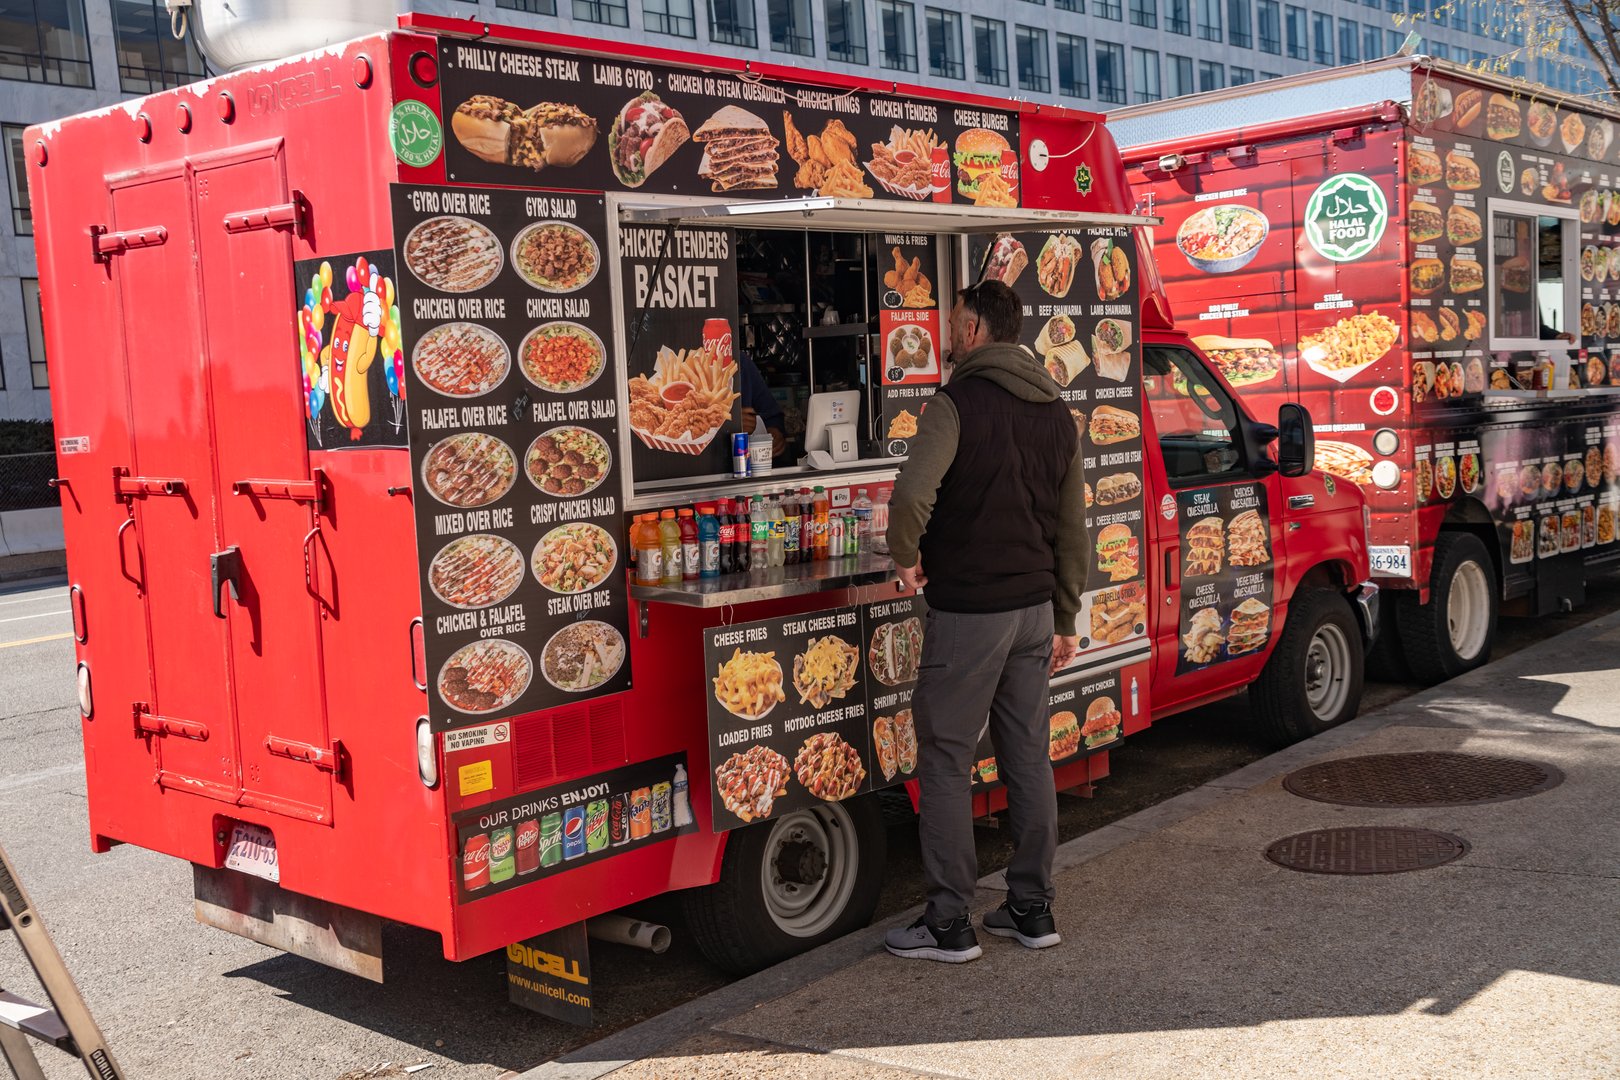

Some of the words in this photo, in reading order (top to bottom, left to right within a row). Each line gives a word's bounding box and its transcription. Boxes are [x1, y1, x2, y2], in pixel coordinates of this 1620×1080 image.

[457, 46, 497, 72] PHILLY
[500, 51, 543, 78] CHEESE
[545, 58, 580, 82] STEAK
[593, 64, 622, 87] LAMB
[625, 68, 654, 91] GYRO
[668, 73, 703, 95] CHICKEN
[704, 81, 715, 96] OR
[717, 82, 741, 100] STEAK
[742, 83, 786, 105] QUESADILLA
[797, 89, 833, 111] CHICKEN
[834, 94, 860, 114] WINGS
[869, 98, 905, 119] CHICKEN
[905, 103, 938, 124] TENDERS
[954, 108, 980, 127] CHEESE
[981, 112, 1008, 131] BURGER
[412, 191, 439, 213] GYRO
[441, 192, 467, 214] OVER
[468, 193, 491, 215] RICE
[525, 197, 549, 218] GYRO
[551, 198, 577, 219] SALAD
[1326, 195, 1369, 217] حلال
[1329, 217, 1365, 229] HALAL
[885, 234, 905, 246] WINGS
[905, 235, 912, 245] &
[912, 235, 928, 247] FRIES
[1329, 226, 1366, 241] FOOD
[674, 230, 729, 260] TENDERS
[634, 264, 719, 309] BASKET
[413, 298, 456, 320] CHICKEN
[458, 298, 480, 320] OVER
[481, 298, 506, 319] RICE
[526, 298, 563, 319] CHICKEN
[564, 298, 590, 318] SALAD
[890, 312, 915, 323] FALAFEL
[916, 311, 930, 322] SIDE
[1039, 305, 1052, 317] BEEF
[1053, 304, 1083, 317] SHAWARMA
[1090, 305, 1103, 316] LAMB
[1104, 304, 1132, 316] SHAWARMA
[887, 389, 899, 399] ADD
[899, 388, 914, 398] FRIES
[915, 387, 920, 397] &
[1072, 389, 1088, 401] STEAK
[1095, 388, 1115, 400] CHICKEN
[1116, 386, 1133, 398] CHEESE
[421, 408, 460, 430] FALAFEL
[462, 406, 486, 428] OVER
[487, 405, 508, 426] RICE
[533, 402, 567, 423] FALAFEL
[568, 401, 589, 421] OVER
[591, 399, 616, 419] SALAD
[1084, 457, 1096, 469] STEAK
[1193, 492, 1210, 505] STEAK
[1234, 486, 1254, 498] CHICKEN
[530, 502, 557, 525] CRISPY
[558, 499, 592, 521] CHICKEN
[592, 497, 615, 518] SALAD
[1186, 502, 1219, 518] QUESADILLA
[1230, 495, 1260, 510] QUESADILLA
[435, 513, 465, 536] MIXED
[466, 511, 490, 533] OVER
[492, 508, 514, 529] RICE
[1096, 514, 1112, 526] CHEESE
[1112, 511, 1127, 524] BURGER
[1235, 572, 1264, 588] VEGETABLE
[1195, 583, 1215, 597] CHEESE
[1233, 583, 1265, 599] QUESADILLA
[547, 597, 573, 617] STEAK
[573, 593, 593, 614] OVER
[594, 590, 611, 609] RICE
[869, 605, 891, 619] STEAK
[891, 600, 912, 615] TACOS
[1189, 592, 1221, 610] QUESADILLA
[436, 611, 478, 635] CHICKEN
[480, 609, 488, 628] &
[489, 604, 526, 626] FALAFEL
[782, 623, 807, 636] STEAK
[808, 616, 836, 632] CHEESE
[836, 612, 857, 627] FRIES
[480, 626, 504, 639] OVER
[506, 622, 526, 635] RICE
[714, 631, 745, 647] CHEESE
[746, 627, 768, 642] FRIES
[1081, 684, 1095, 696] SPICY
[1095, 678, 1115, 693] CHICKEN
[873, 694, 898, 710] SHRIMP
[1053, 690, 1075, 705] CHICKEN
[784, 716, 815, 734] HOTDOG
[816, 710, 844, 727] CHEESE
[845, 703, 865, 720] FRIES
[447, 733, 457, 742] NO
[458, 728, 488, 740] SMOKING
[450, 741, 460, 749] NO
[461, 736, 485, 747] VAPING
[718, 731, 749, 747] LOADED
[751, 724, 773, 739] FRIES
[480, 812, 508, 829] OUR
[511, 797, 559, 822] DRINKS
[562, 782, 610, 806] ENJOY!
[508, 973, 591, 1008] www.unicell.com
